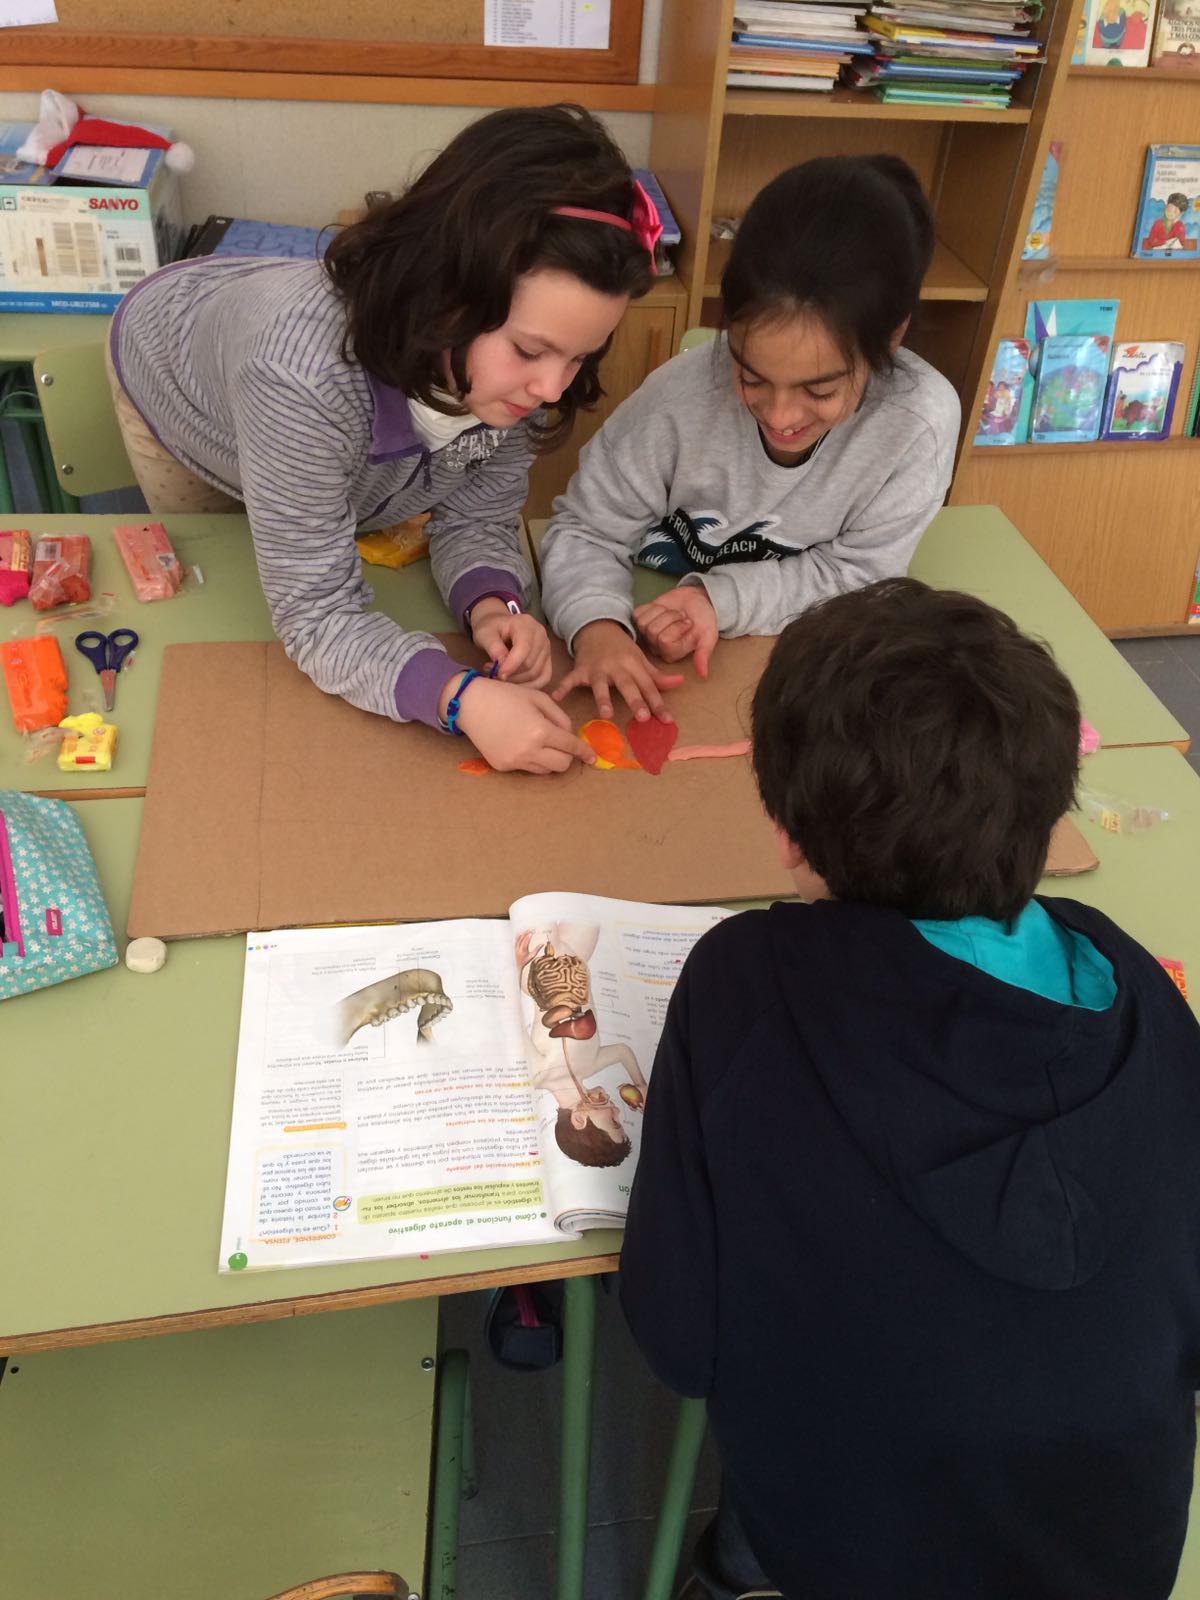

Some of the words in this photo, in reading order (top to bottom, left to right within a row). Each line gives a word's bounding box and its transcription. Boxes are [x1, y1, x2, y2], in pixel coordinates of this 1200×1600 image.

[89, 197, 139, 211] SANYO
[667, 513, 691, 547] FROM
[687, 539, 714, 565] LONG
[716, 540, 757, 559] BEACH
[478, 1215, 511, 1224] funciona
[515, 1213, 537, 1221] Cómo
[430, 1219, 462, 1228] aparato
[388, 1224, 426, 1234] digestivo
